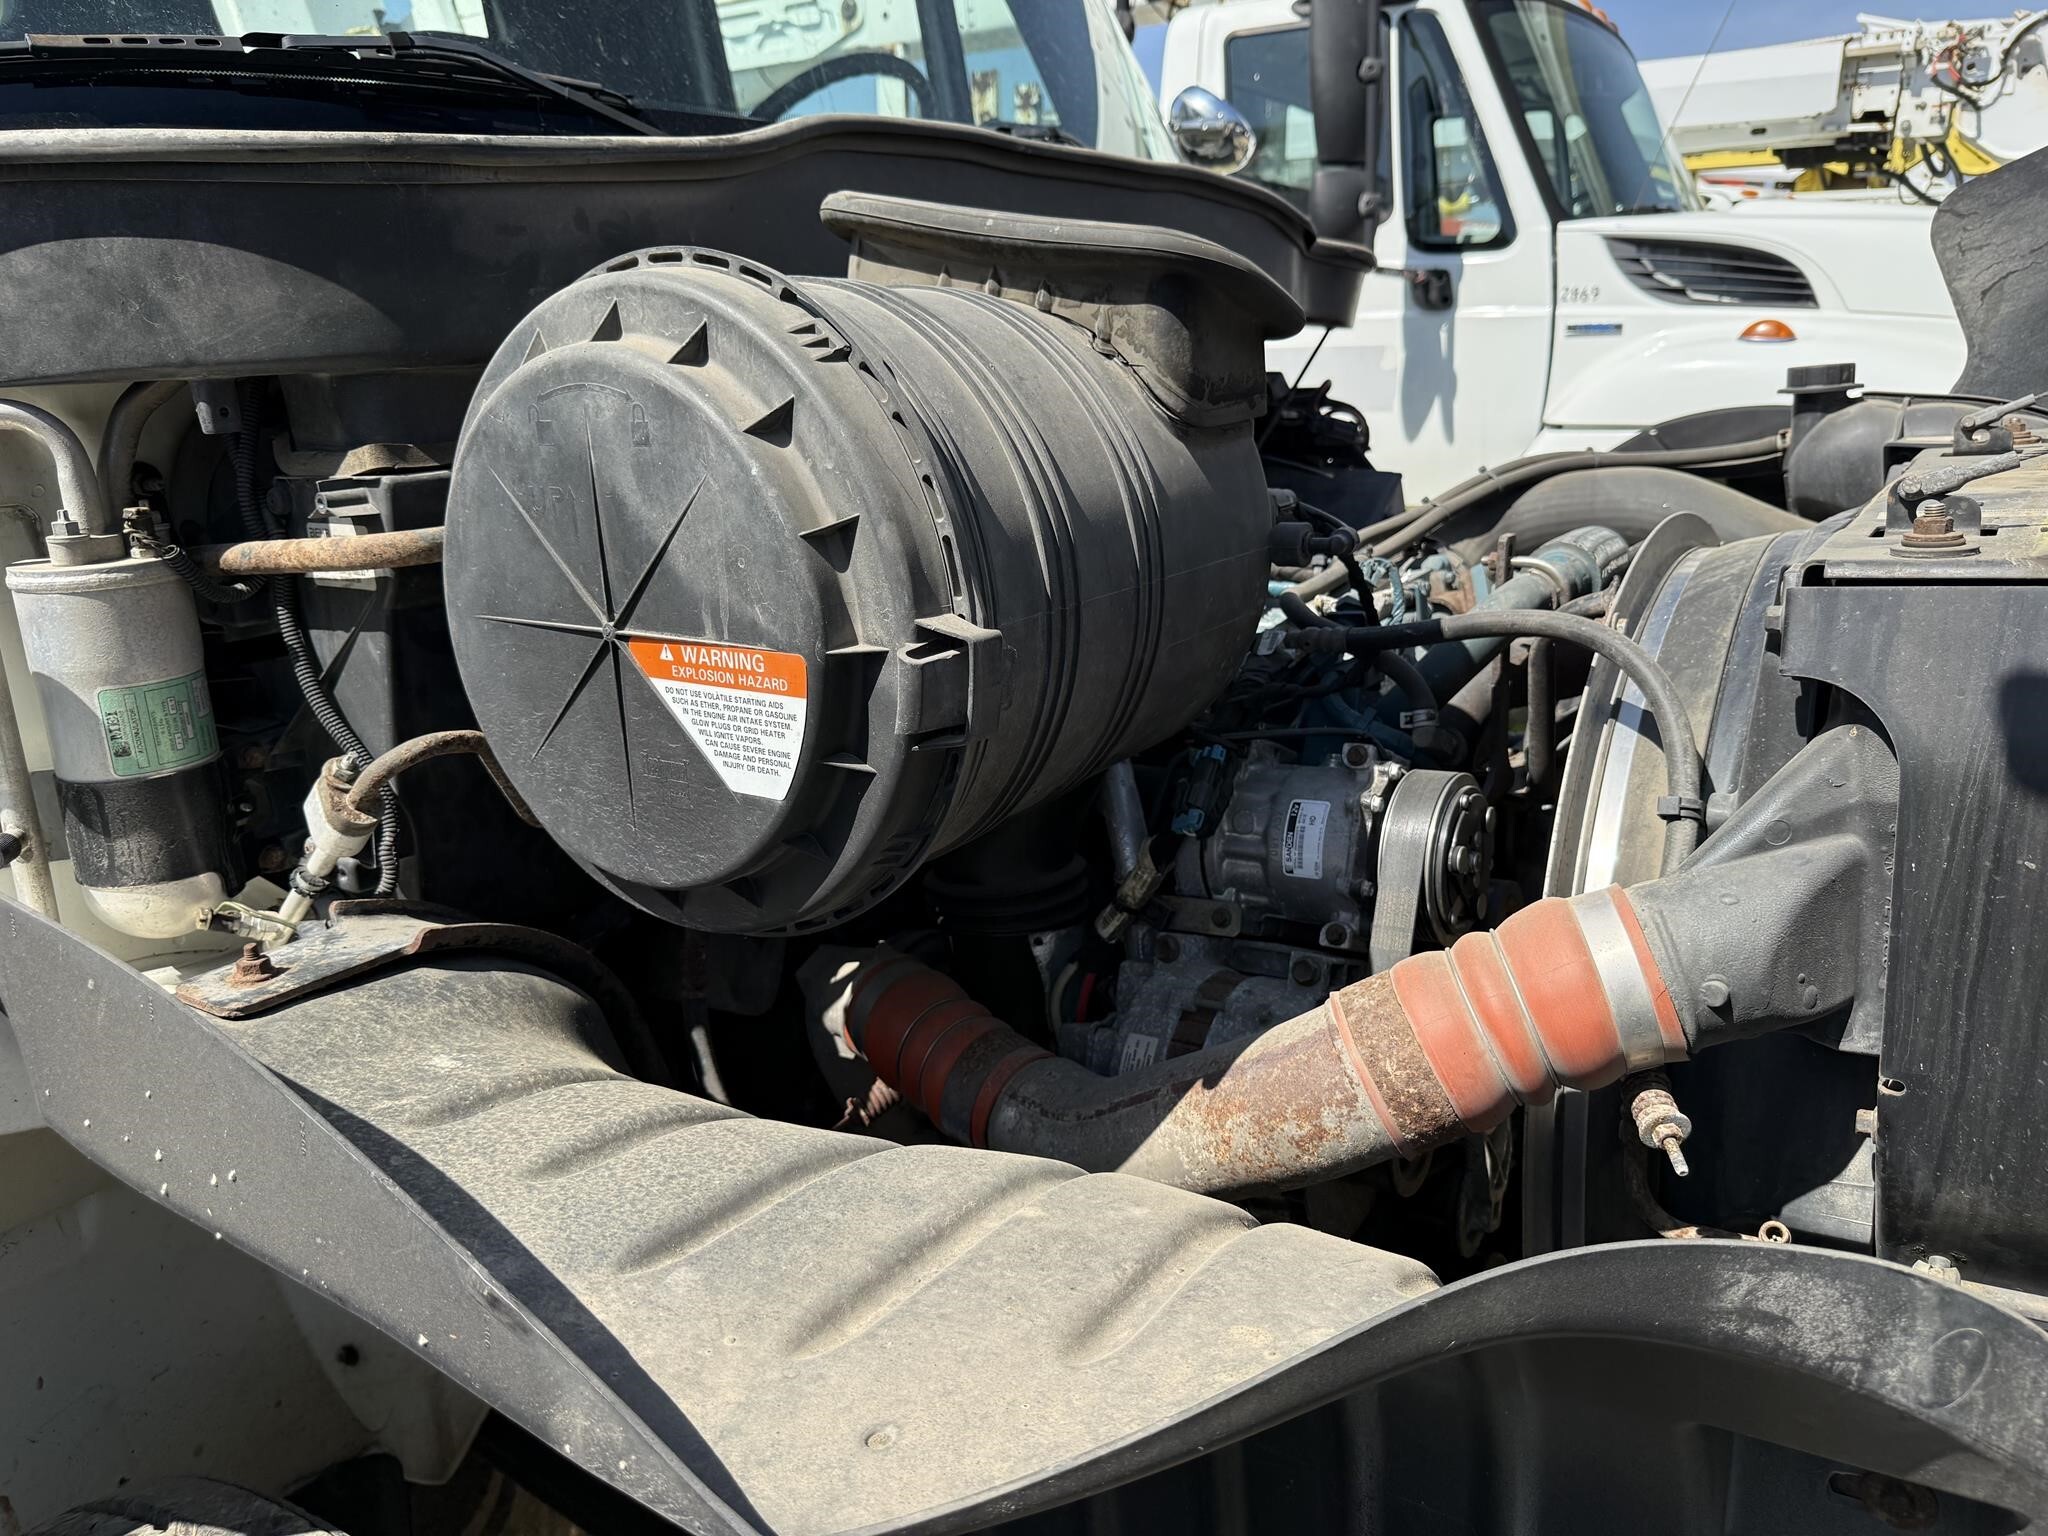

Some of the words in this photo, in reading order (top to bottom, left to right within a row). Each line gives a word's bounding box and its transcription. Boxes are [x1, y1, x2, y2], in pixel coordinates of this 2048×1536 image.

[680, 646, 764, 672] WARNING
[672, 665, 734, 684] EXPLOSION
[739, 674, 787, 691] HAZARD
[665, 686, 674, 694] DO
[676, 688, 688, 696] NOT
[690, 689, 701, 698] USE
[703, 691, 732, 702] VOLATILE
[734, 696, 766, 707] STARTING
[768, 701, 783, 709] AIDS
[672, 697, 688, 705] SUCH
[701, 701, 721, 711] ETHER,
[723, 704, 752, 715] PROPANE
[765, 711, 797, 721] GASOLINE
[691, 709, 702, 717] THE
[704, 711, 725, 720] ENGINE
[728, 714, 738, 722] AIR
[740, 716, 762, 726] INTAKE
[765, 720, 792, 730] SYSTEM.
[105, 711, 123, 741] MEI
[692, 718, 709, 728] GLOW
[711, 721, 730, 731] PLUGS
[733, 725, 741, 733] OR
[743, 726, 758, 735] GRID
[761, 729, 785, 739] HEATER
[698, 729, 712, 737] WILL
[714, 731, 733, 741] IGNITE
[735, 734, 763, 745] VAPORS.
[705, 739, 718, 747] CAN
[720, 741, 741, 751] CAUSE
[743, 745, 766, 755] SEVERE
[768, 749, 791, 759] ENGINE
[714, 750, 741, 760] DAMAGE
[743, 755, 756, 763] AND
[758, 758, 791, 769] PERSONAL
[723, 761, 744, 771] INJURY
[747, 764, 755, 772] OR
[757, 767, 781, 776] DEATH.
[1286, 831, 1294, 863] SANDEN
